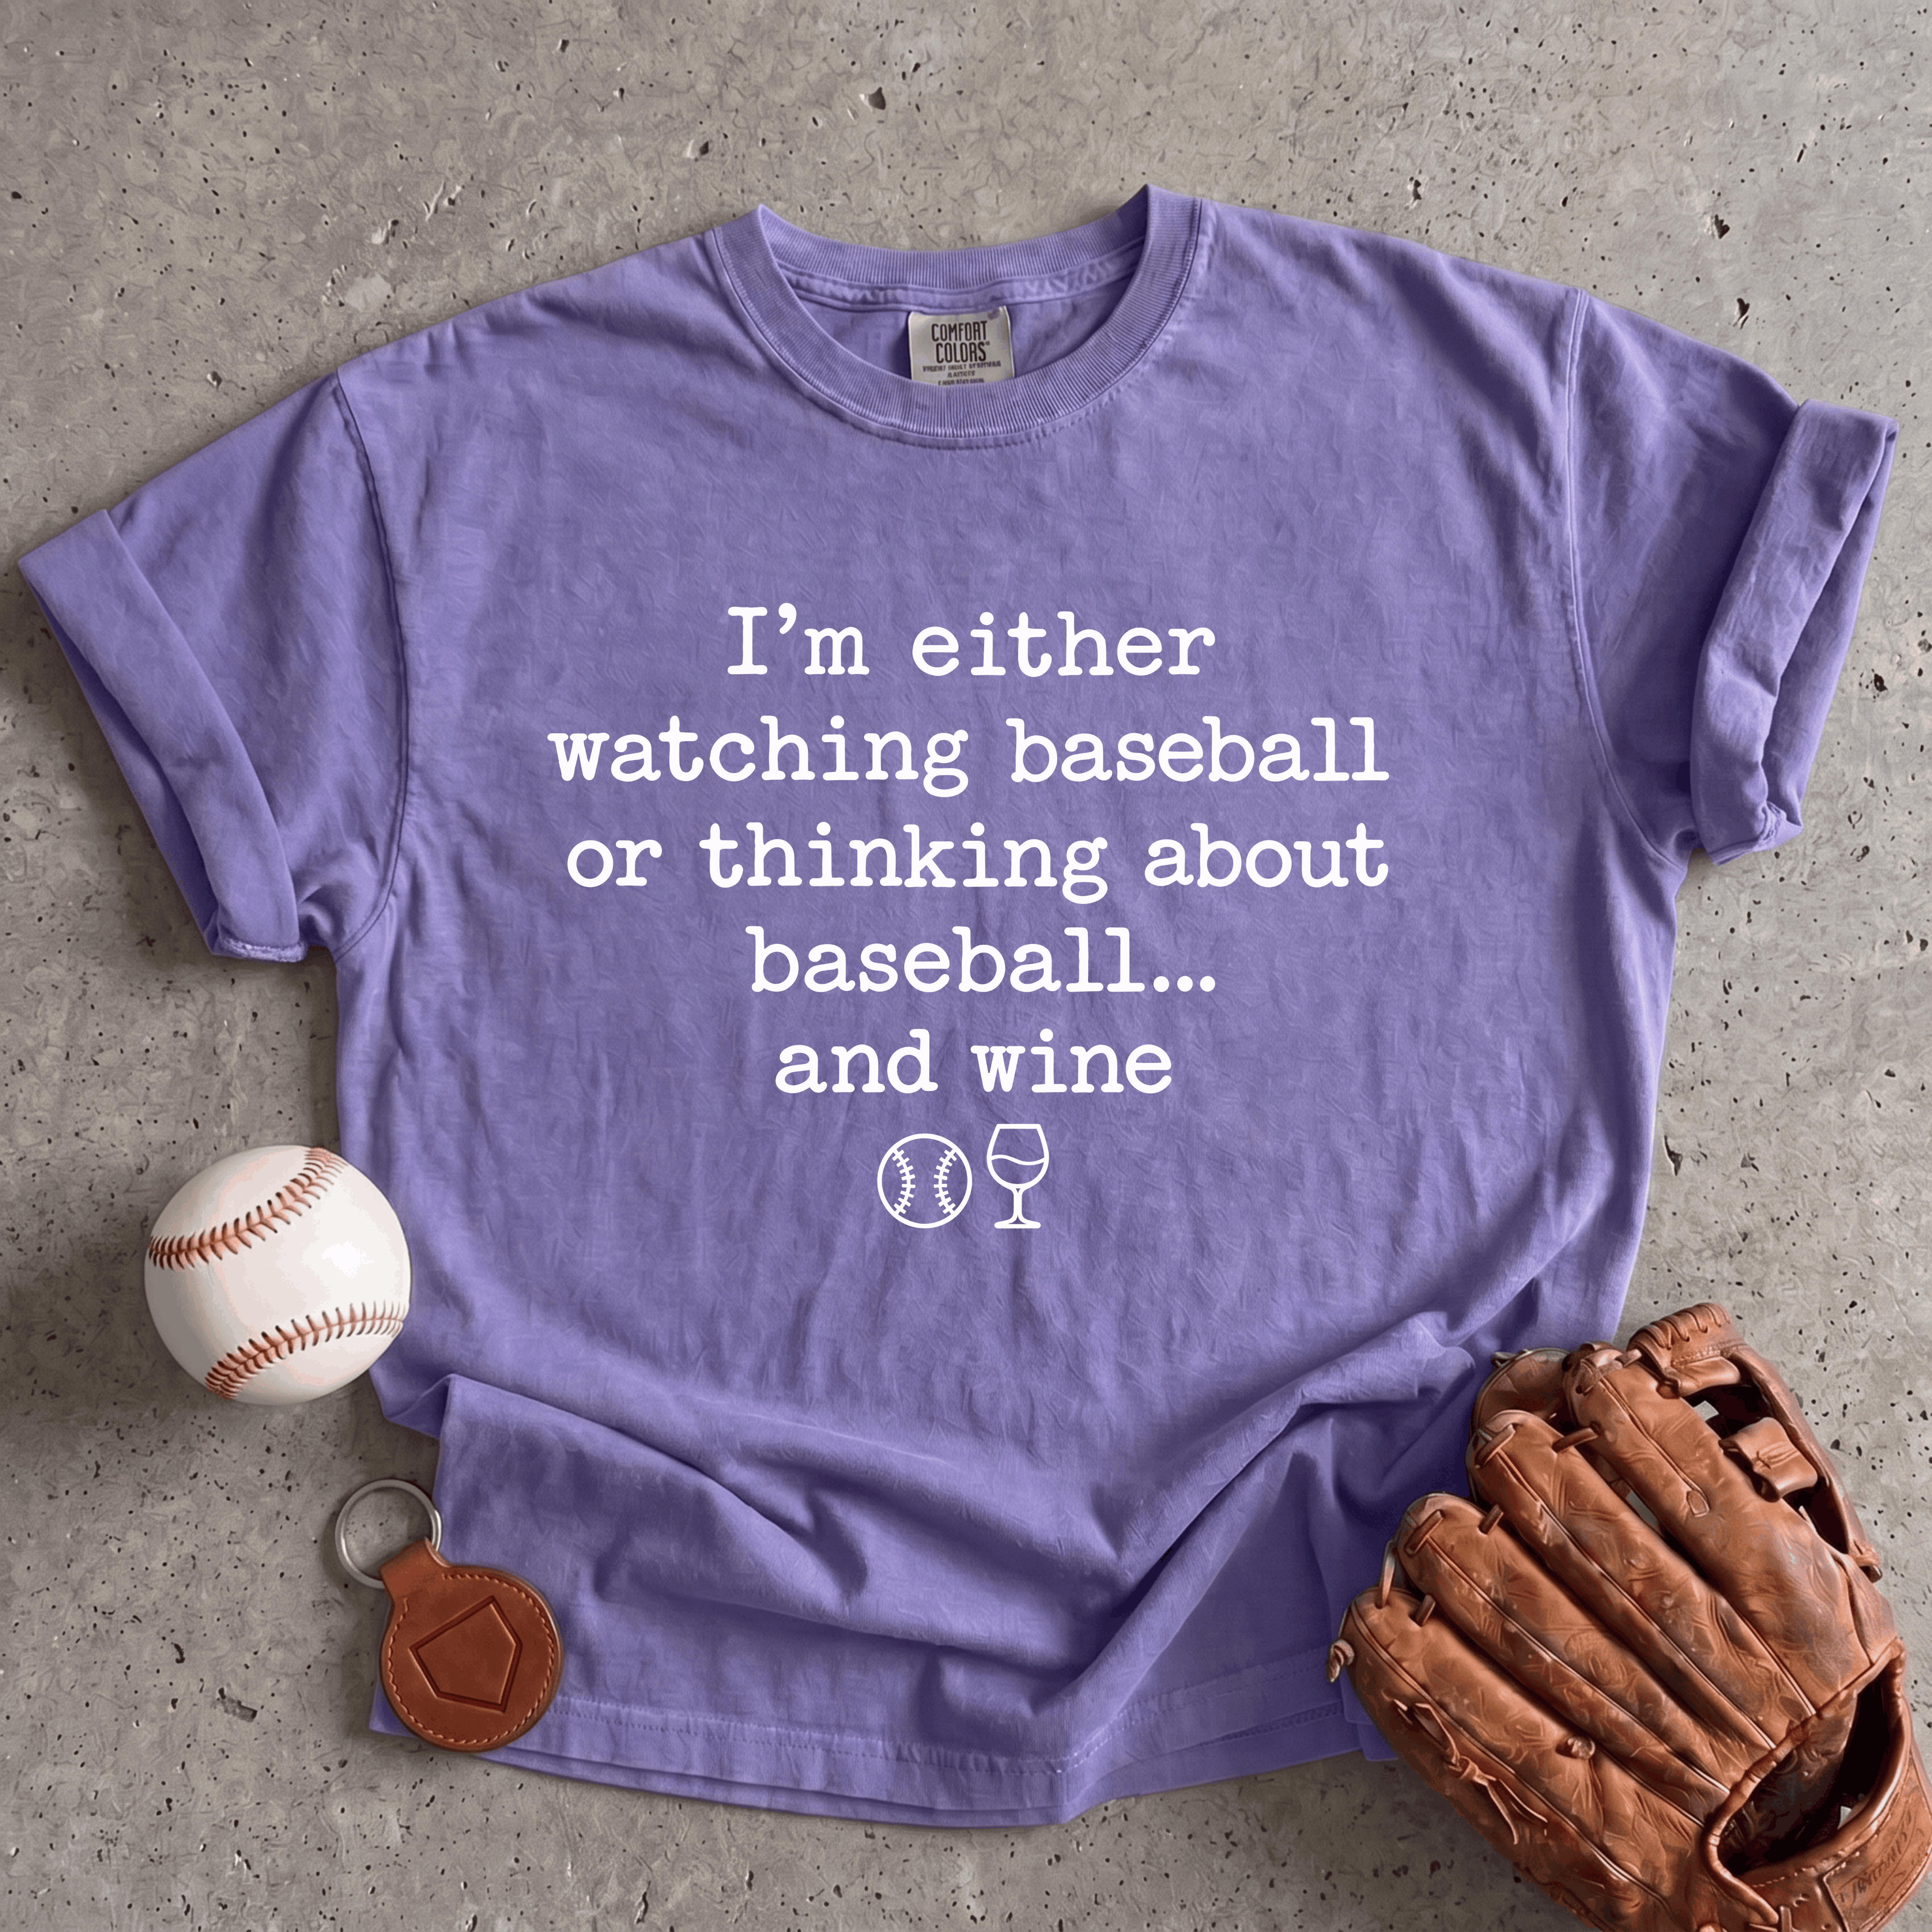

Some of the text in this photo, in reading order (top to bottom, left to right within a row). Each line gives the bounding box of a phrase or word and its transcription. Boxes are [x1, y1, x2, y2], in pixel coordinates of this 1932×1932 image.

[931, 320, 987, 342] COMFORT
[728, 603, 1215, 677] I’m either
[547, 715, 1389, 798] watching baseball
[567, 821, 1388, 904] or thinking about
[745, 926, 1215, 993] baseball...
[776, 1028, 1172, 1094] and wine
